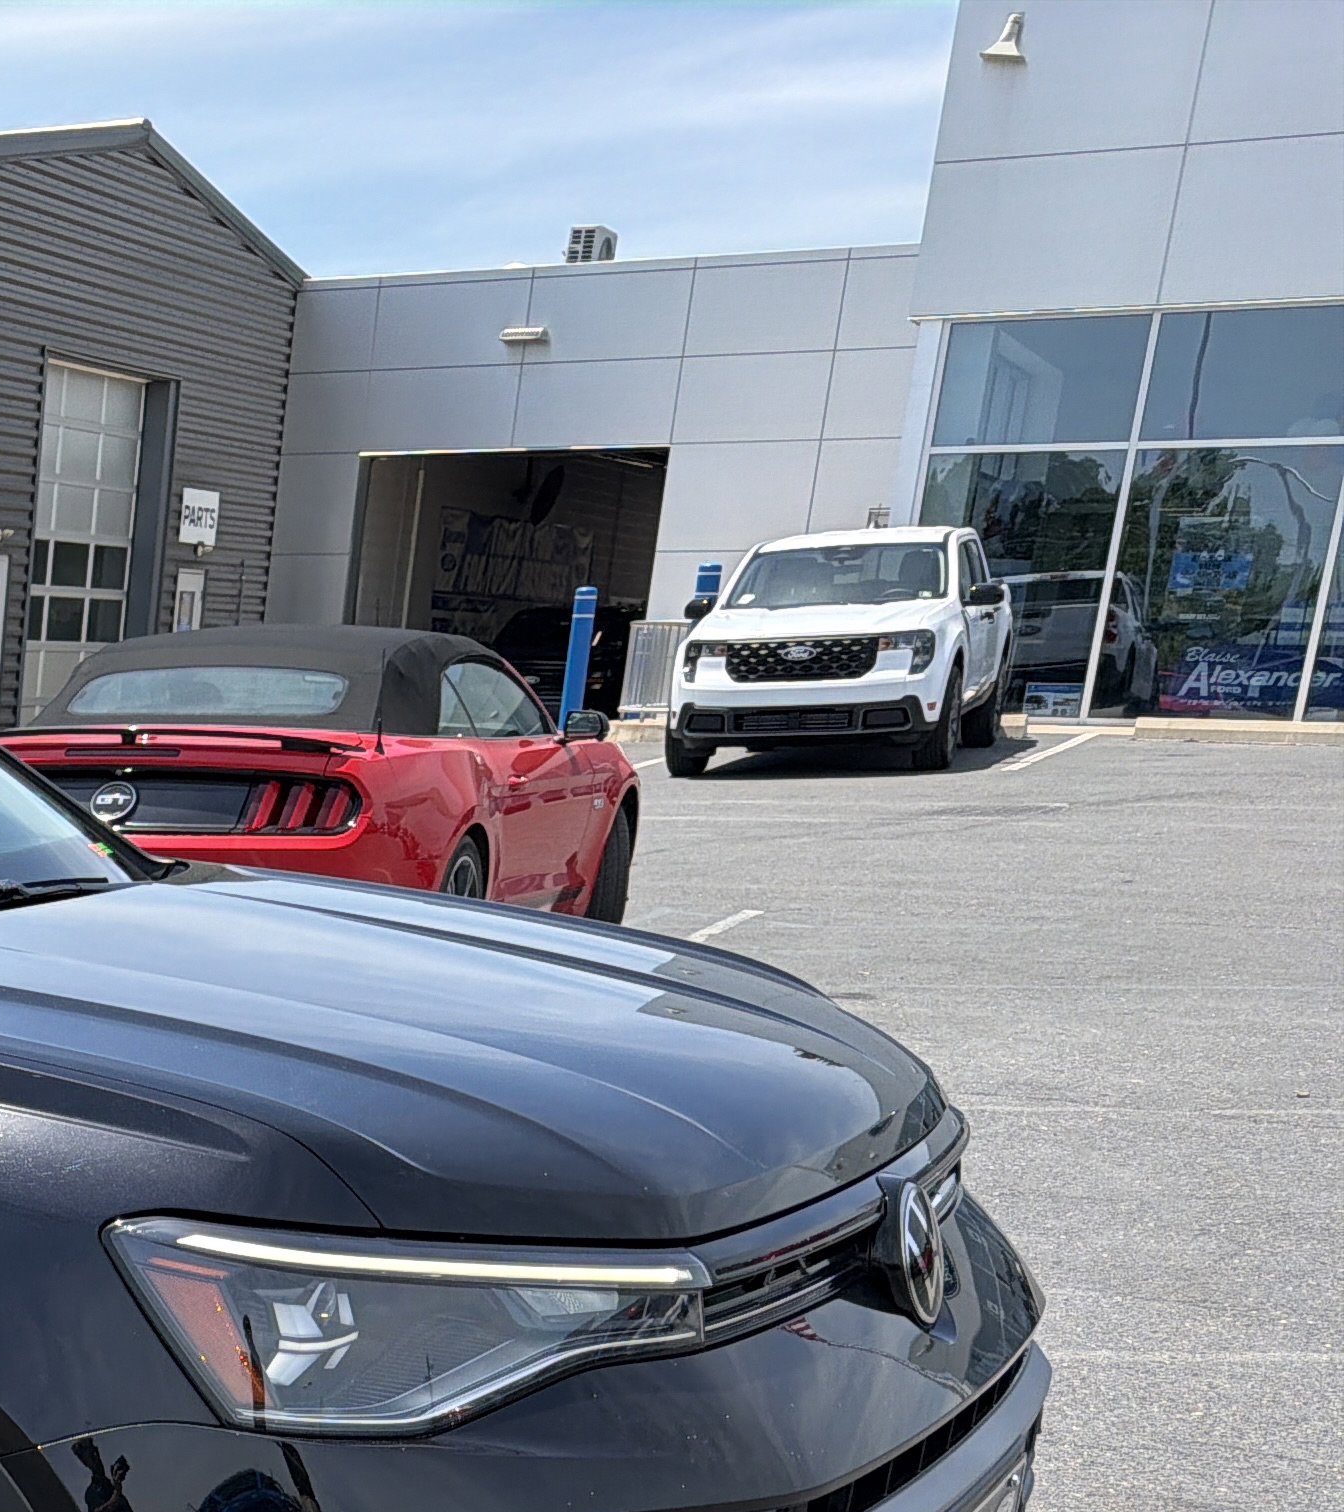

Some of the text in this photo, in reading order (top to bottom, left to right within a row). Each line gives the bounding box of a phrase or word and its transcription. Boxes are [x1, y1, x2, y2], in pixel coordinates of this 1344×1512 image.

[183, 505, 216, 529] PARTS
[1185, 646, 1241, 662] Blaise
[1210, 685, 1242, 694] FORD
[96, 793, 131, 805] GT
